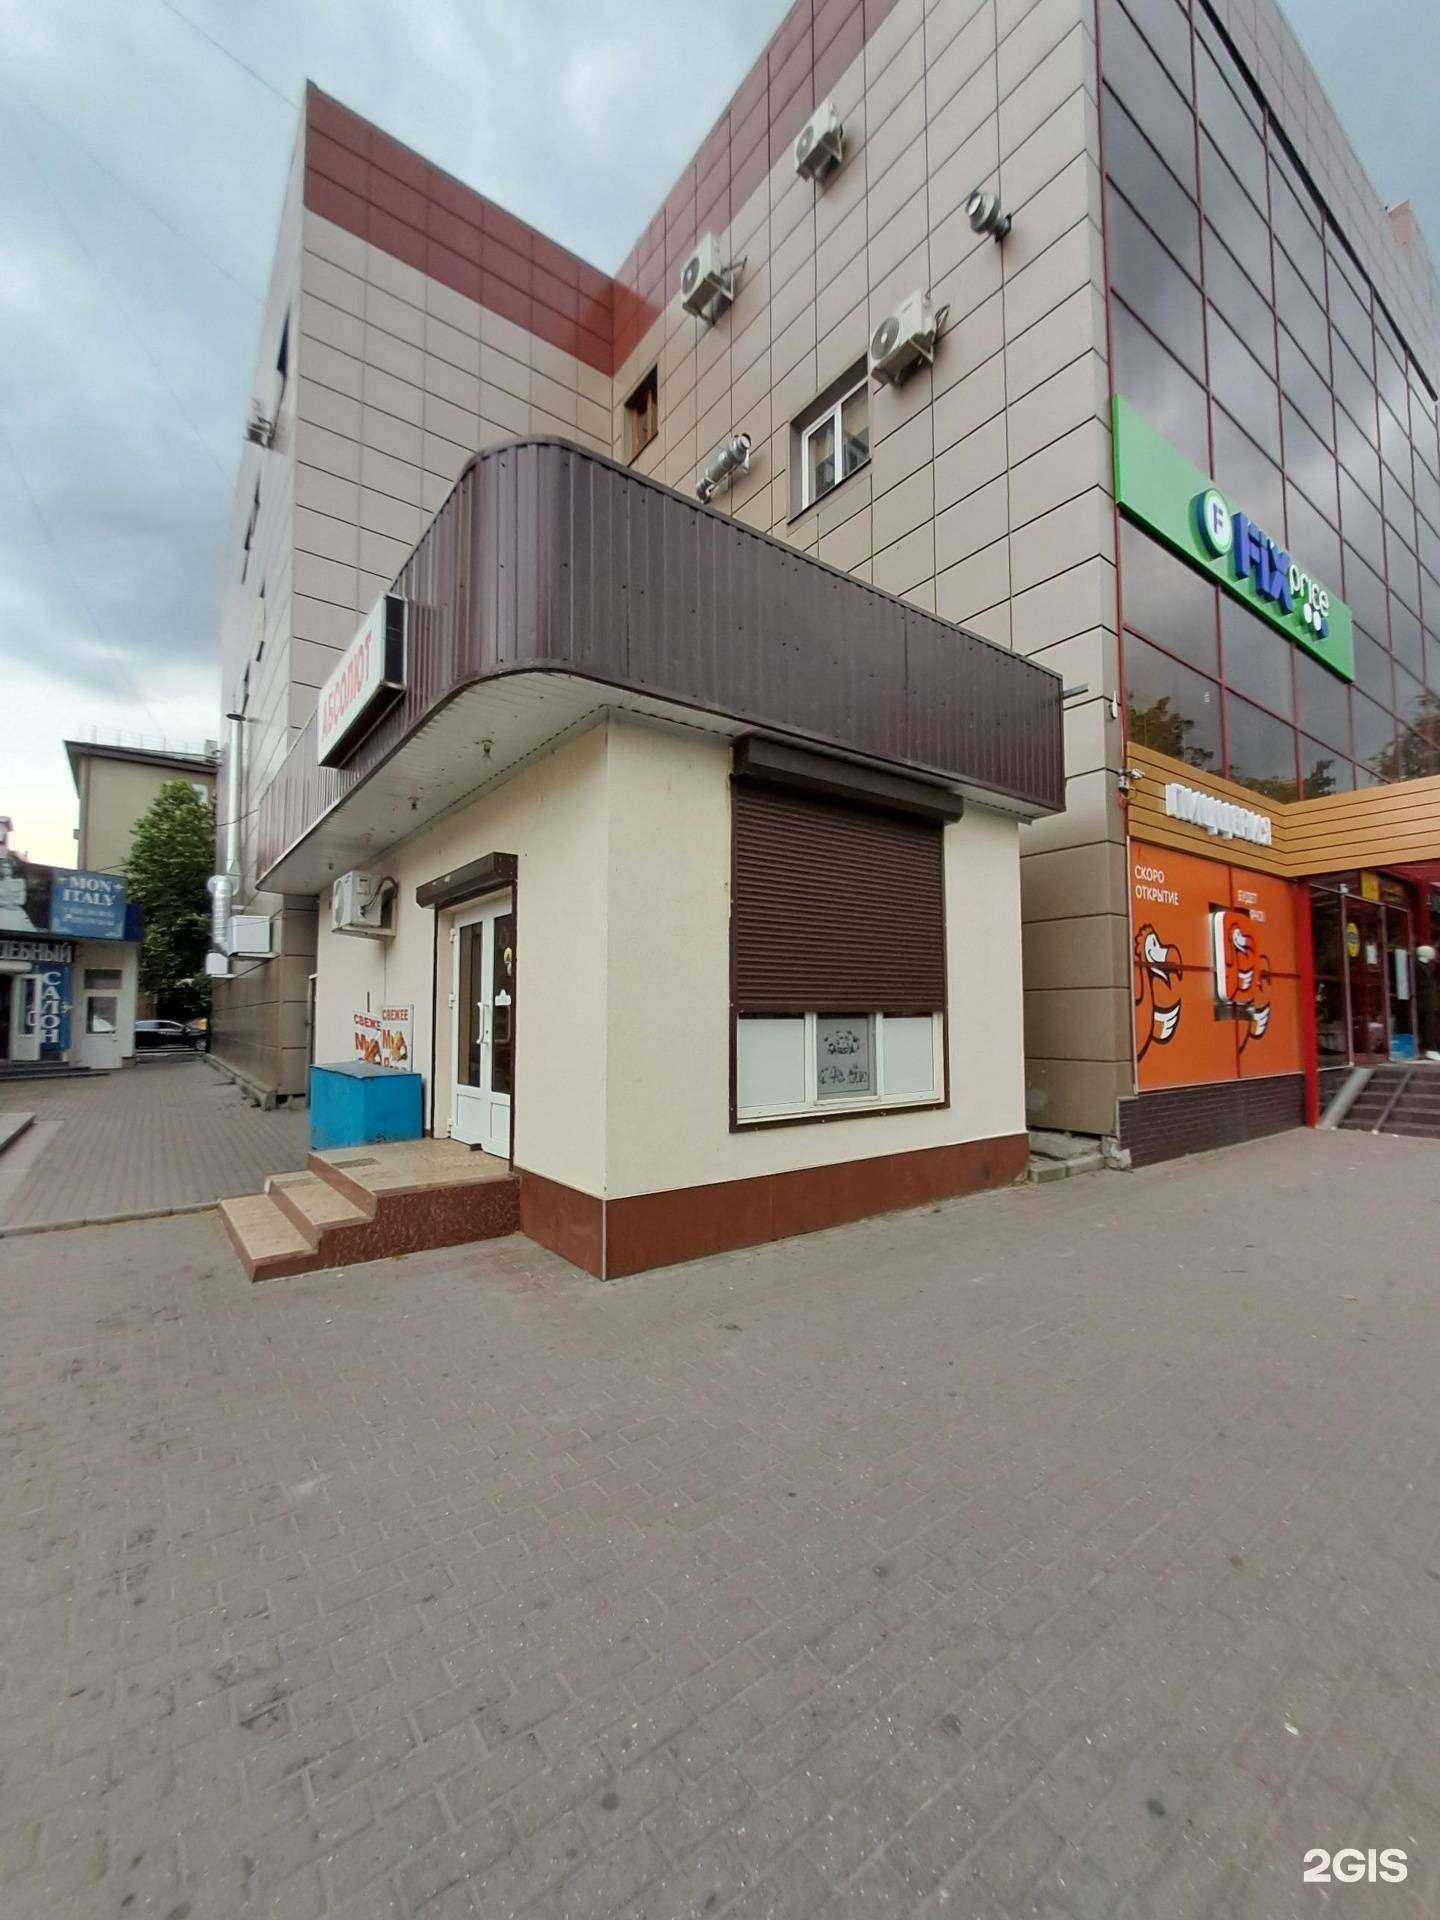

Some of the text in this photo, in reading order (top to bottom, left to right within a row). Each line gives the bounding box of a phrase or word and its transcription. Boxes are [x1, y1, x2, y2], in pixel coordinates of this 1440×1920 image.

[1289, 564, 1330, 617] price
[1165, 782, 1272, 846] ПИЦЦЕРИЯ
[69, 876, 112, 892] MON
[1134, 864, 1165, 884] СКОРО
[63, 888, 116, 906] ITALY
[1135, 884, 1180, 906] ОТКРЫТИЕ
[41, 971, 61, 1043] САЛОН
[382, 1008, 409, 1021] СВЕЖЕЕ
